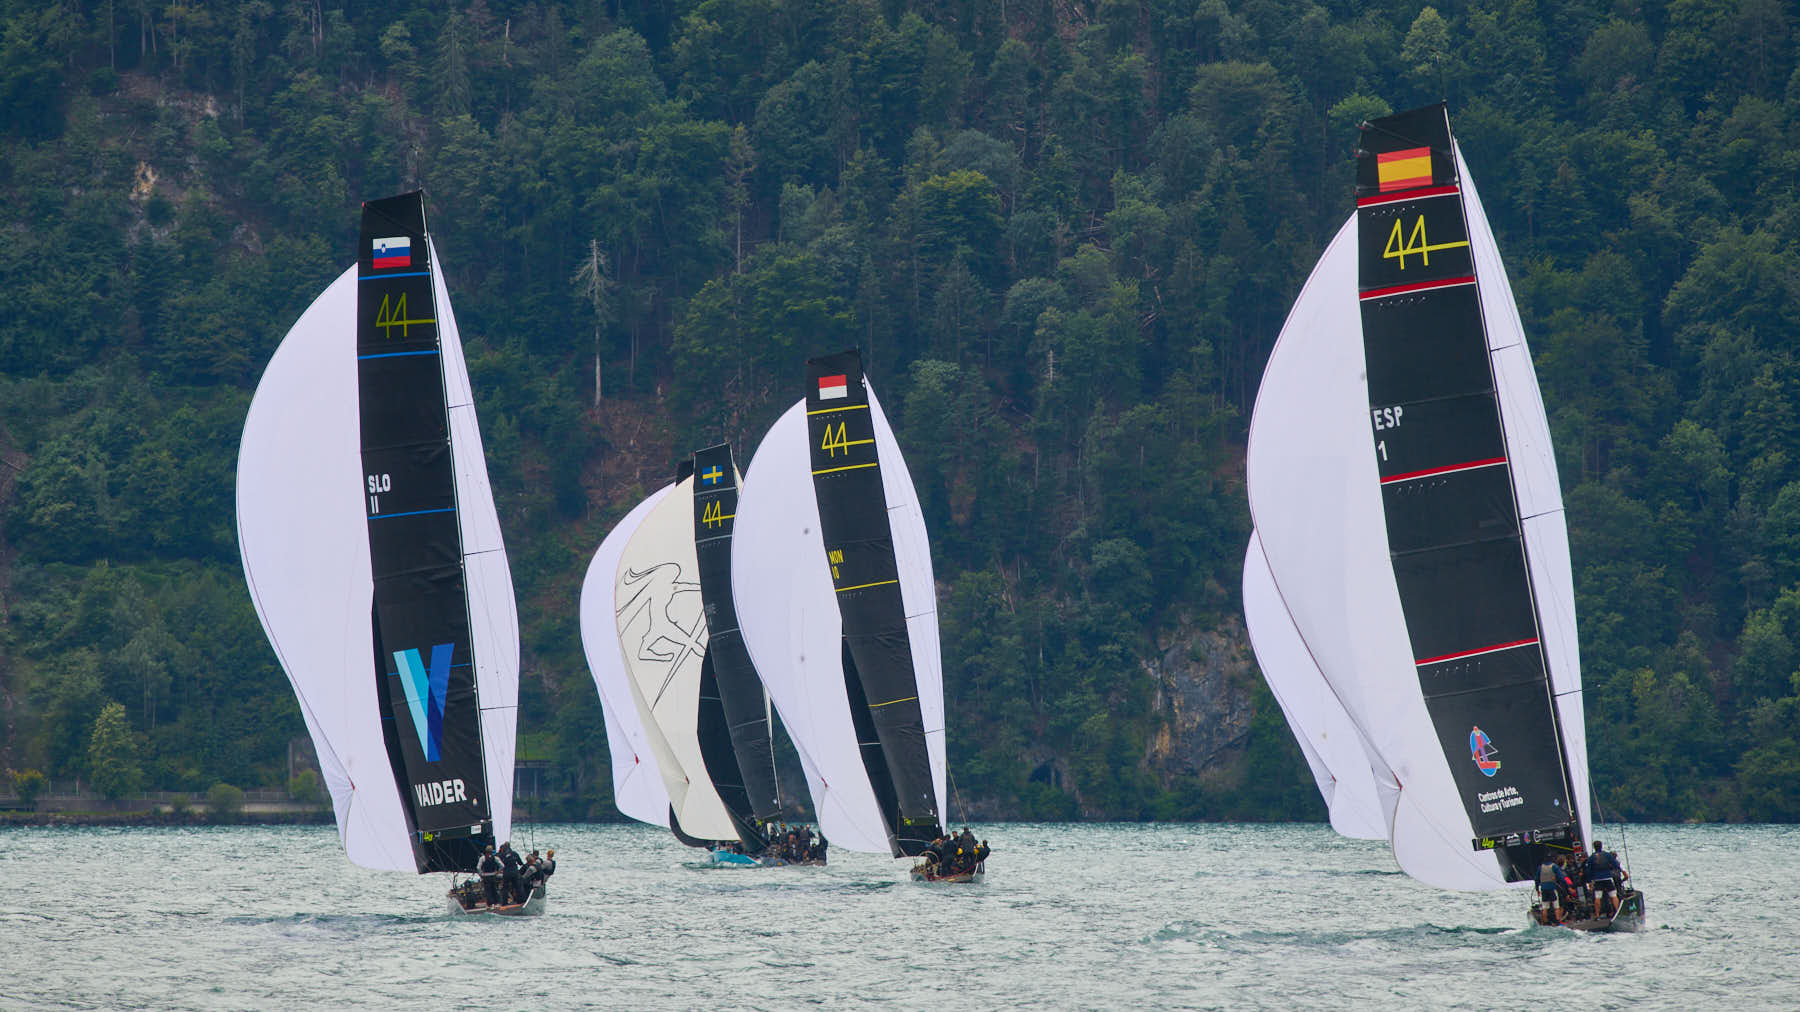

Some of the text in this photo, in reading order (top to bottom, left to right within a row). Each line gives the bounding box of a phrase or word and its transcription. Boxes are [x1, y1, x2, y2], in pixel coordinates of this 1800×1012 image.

[1373, 405, 1403, 431] ESP
[1378, 440, 1388, 461] 1
[368, 473, 391, 493] SLO
[415, 778, 467, 807] VAIDER
